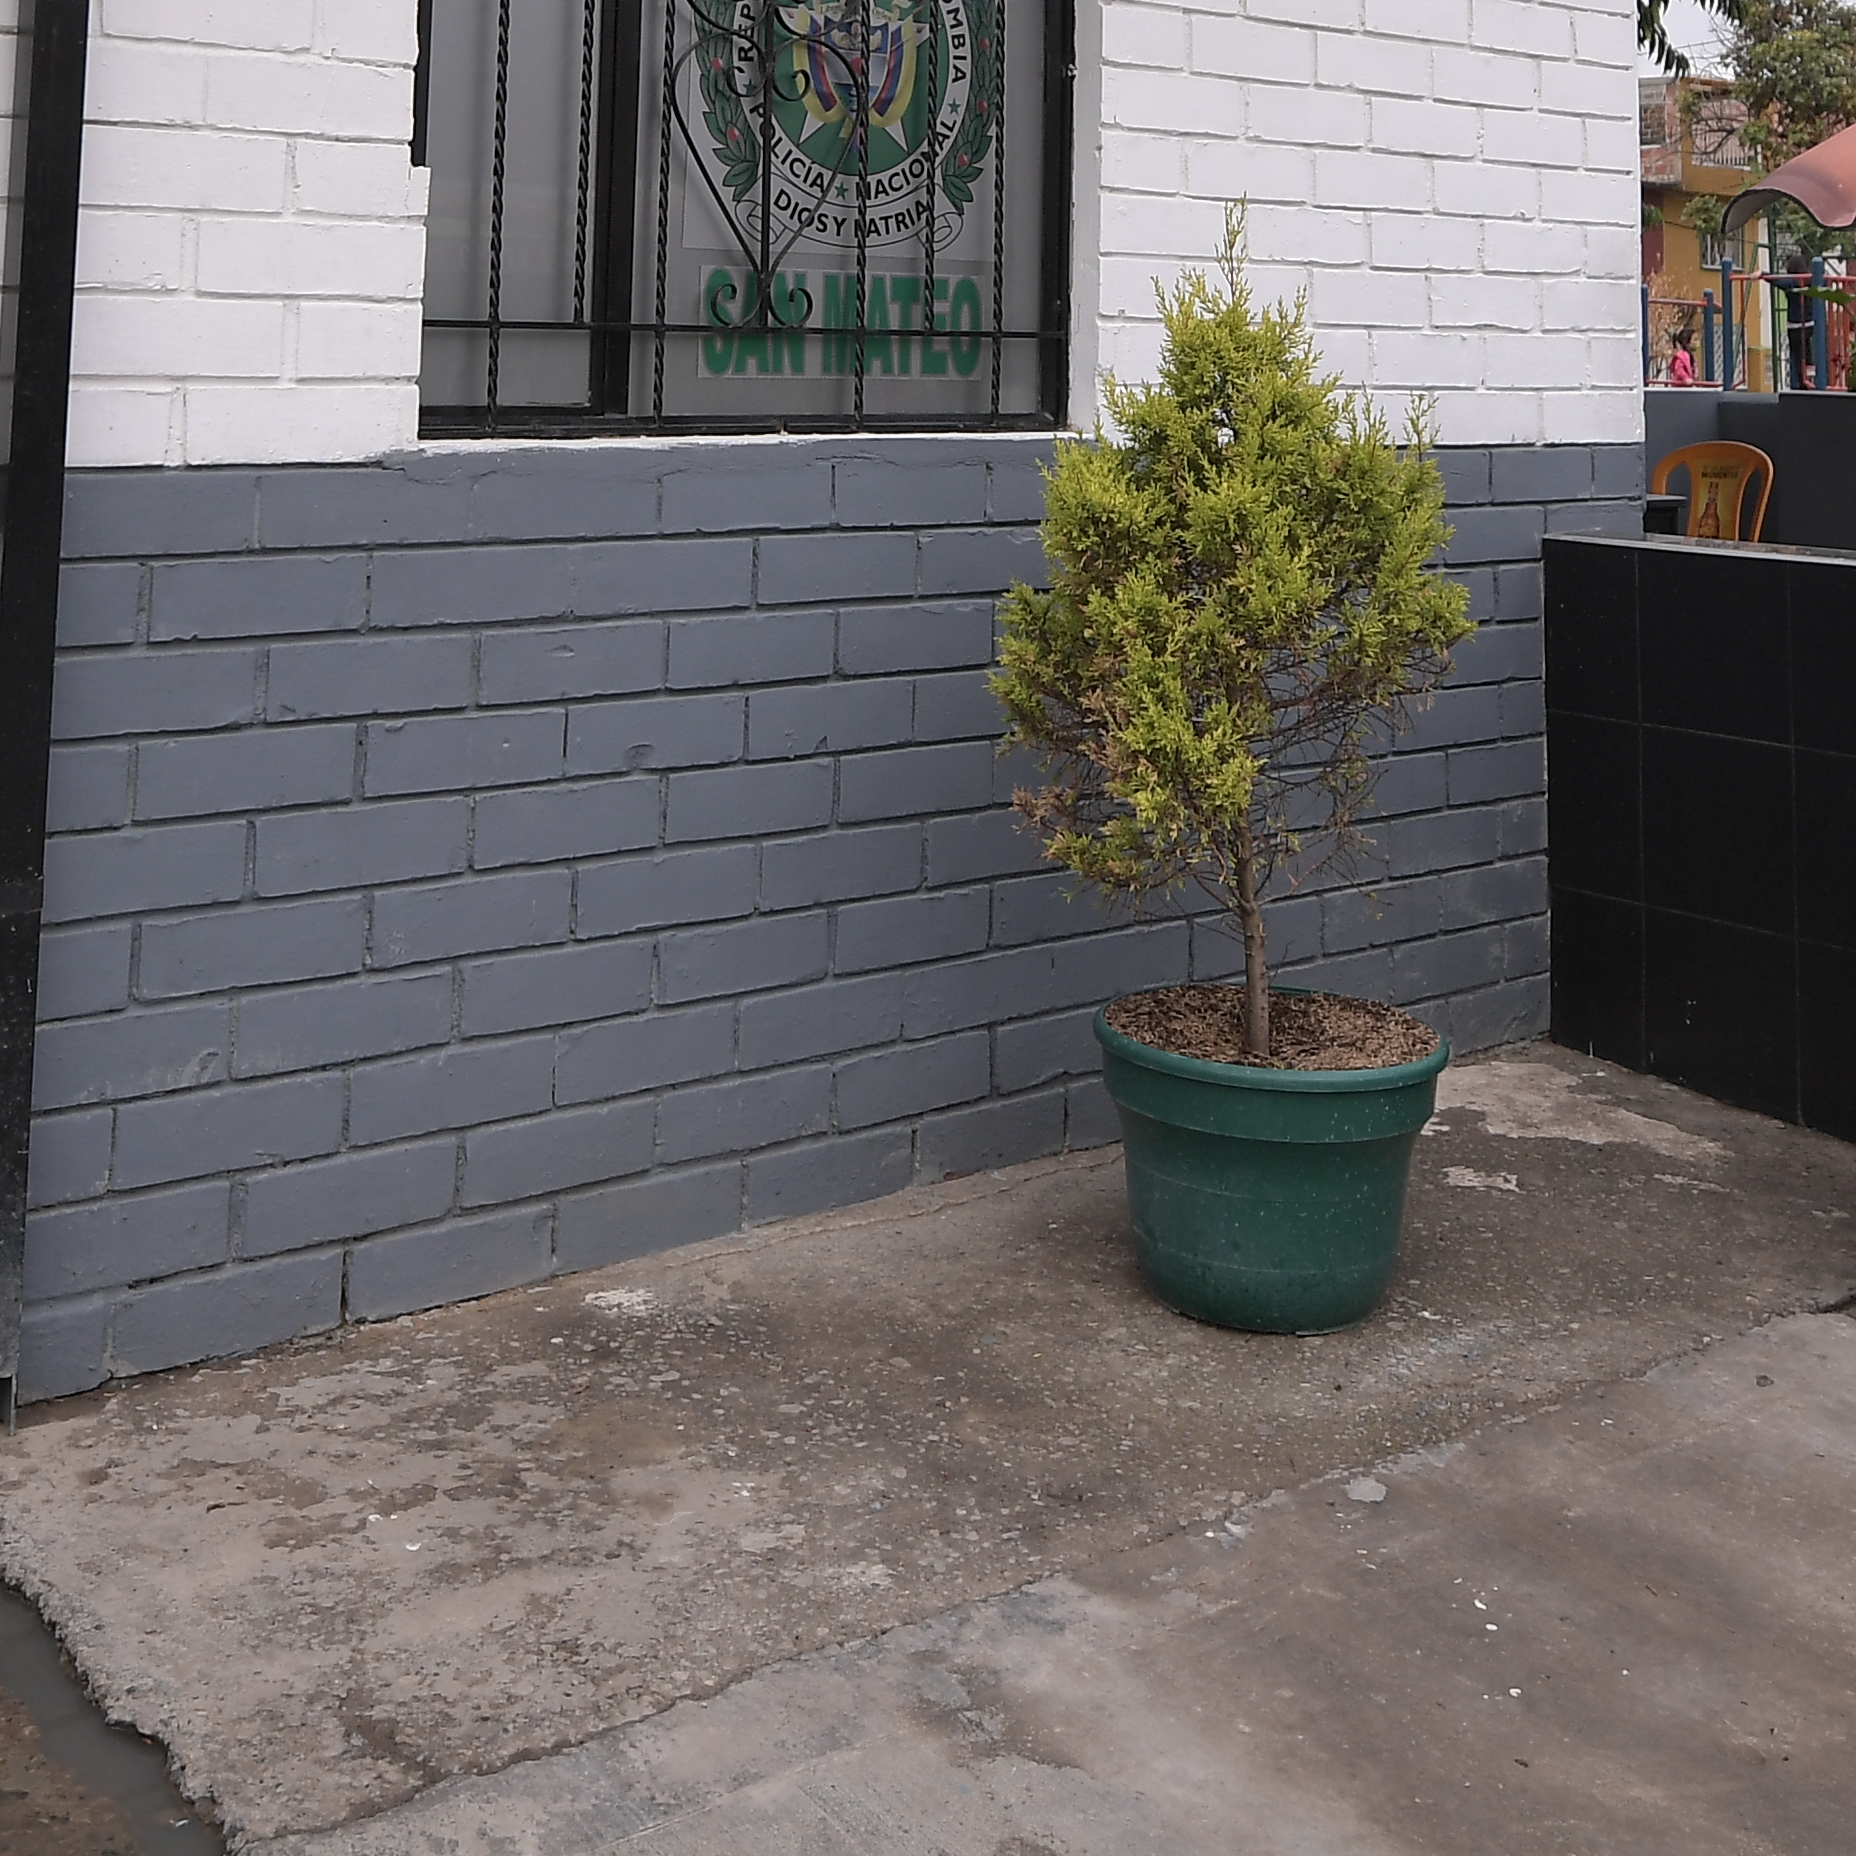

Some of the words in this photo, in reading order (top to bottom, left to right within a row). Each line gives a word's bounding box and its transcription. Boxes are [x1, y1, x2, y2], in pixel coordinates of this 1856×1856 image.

[748, 102, 828, 194] POLICÍA
[855, 119, 957, 201] NACIONAL
[703, 268, 807, 375] SAN
[822, 274, 983, 377] MATEO
